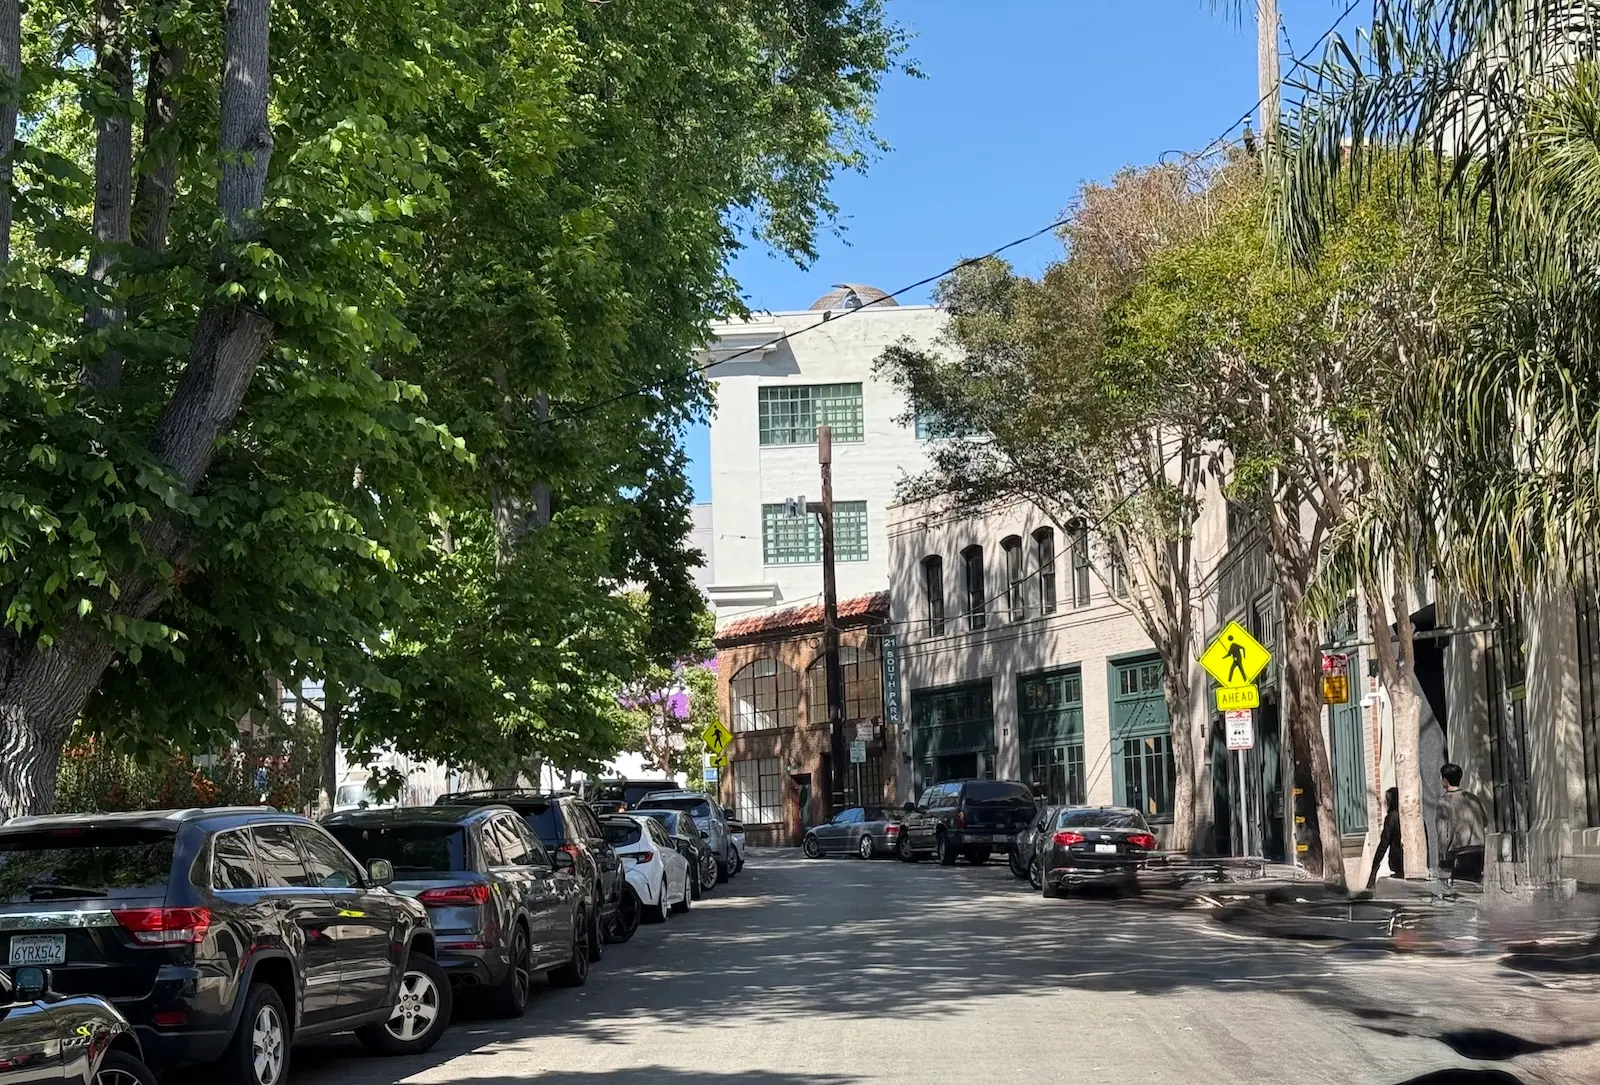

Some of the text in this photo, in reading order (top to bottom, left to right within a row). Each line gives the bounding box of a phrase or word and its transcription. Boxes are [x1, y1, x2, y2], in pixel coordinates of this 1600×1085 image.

[884, 638, 898, 721] 21 SOUTH PARK
[1222, 691, 1254, 704] AHEAD
[14, 945, 61, 960] 6YRX542
